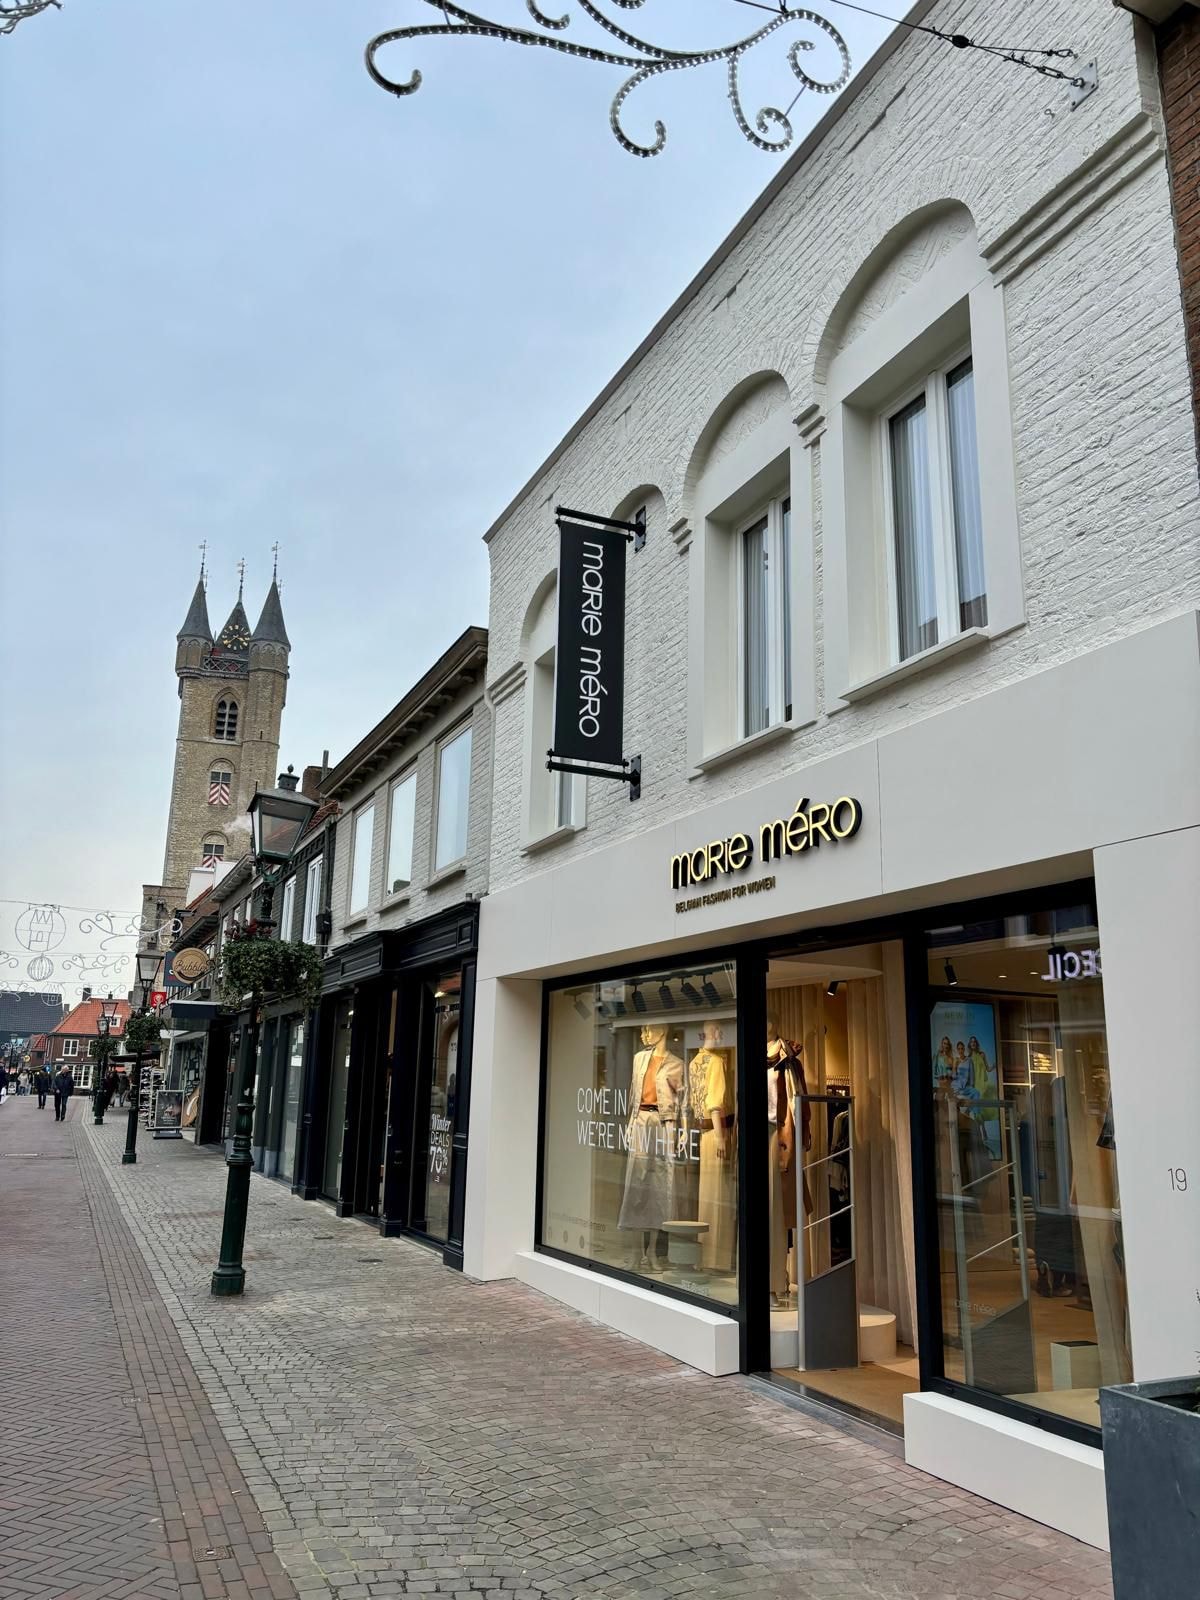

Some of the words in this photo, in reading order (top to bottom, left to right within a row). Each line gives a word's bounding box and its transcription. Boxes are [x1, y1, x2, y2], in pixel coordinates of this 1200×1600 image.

[675, 898, 702, 914] BELGIAN
[702, 889, 732, 907] FASHION
[732, 880, 747, 899] FOR
[747, 875, 776, 894] WOMEN
[577, 1087, 611, 1115] COME
[614, 1089, 627, 1116] IN
[431, 1114, 451, 1132] Winter
[430, 1131, 450, 1147] DEALS
[577, 1120, 615, 1149] WE'RE
[618, 1123, 652, 1154] NEW
[655, 1125, 700, 1161] HERE
[1167, 1168, 1188, 1191] 19
